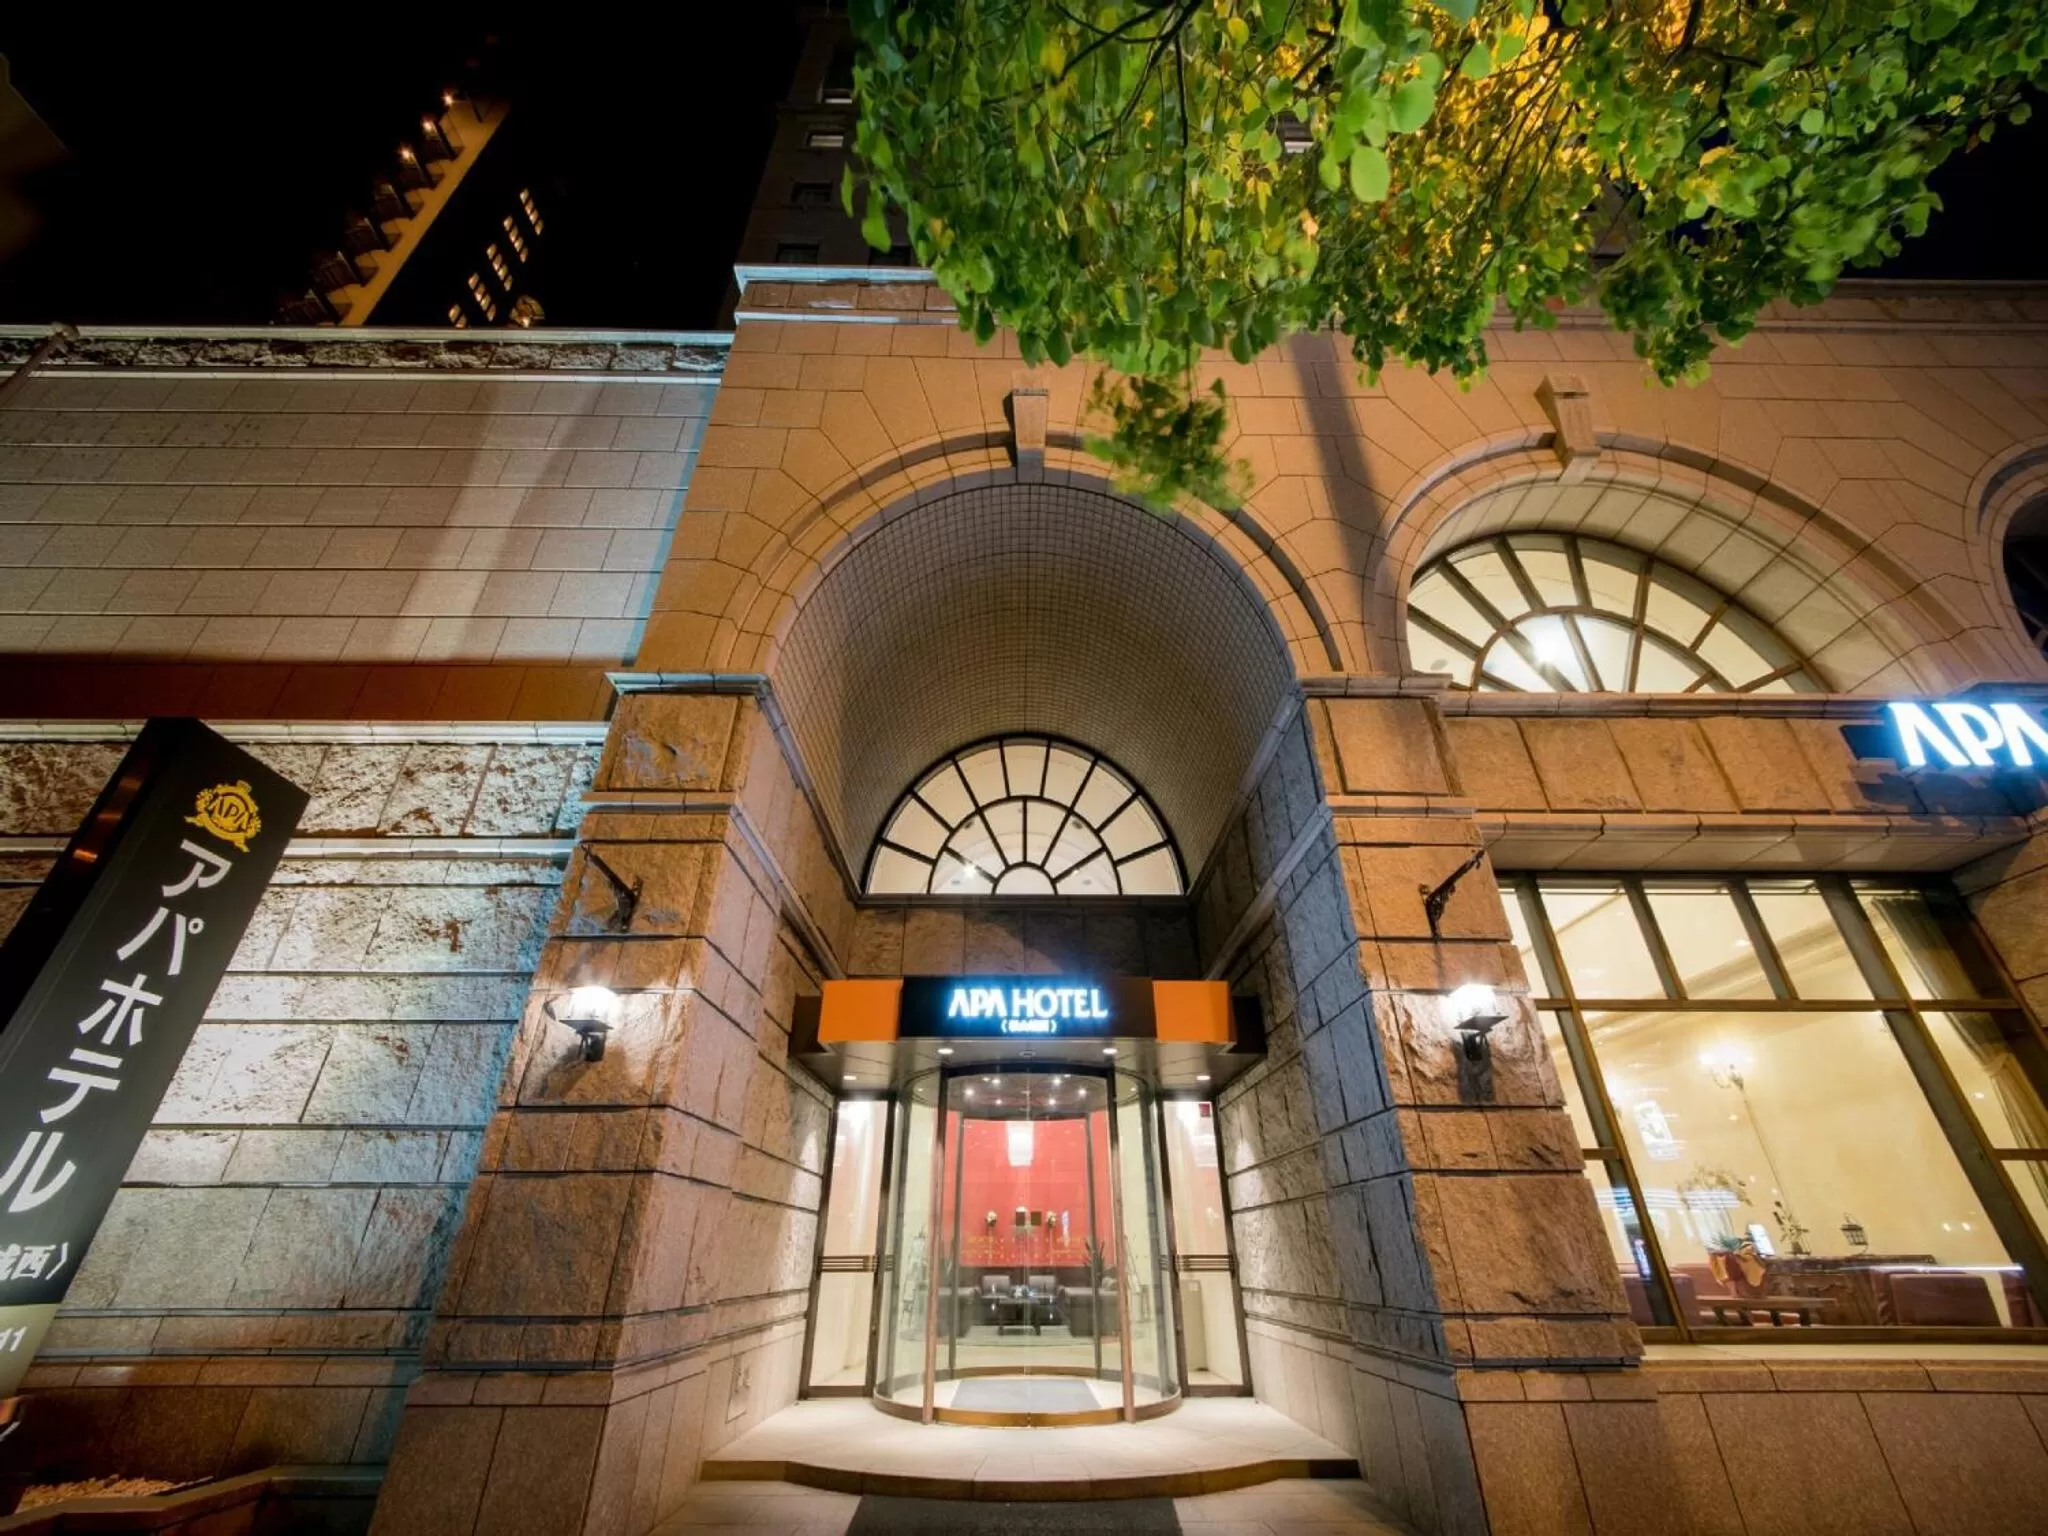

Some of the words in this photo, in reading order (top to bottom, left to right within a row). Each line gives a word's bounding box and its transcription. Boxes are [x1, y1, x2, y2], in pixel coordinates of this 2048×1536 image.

[1888, 702, 2048, 767] APA
[0, 839, 233, 1213] アパホテル
[948, 988, 1008, 1018] APA
[1011, 988, 1109, 1018] HOTEL
